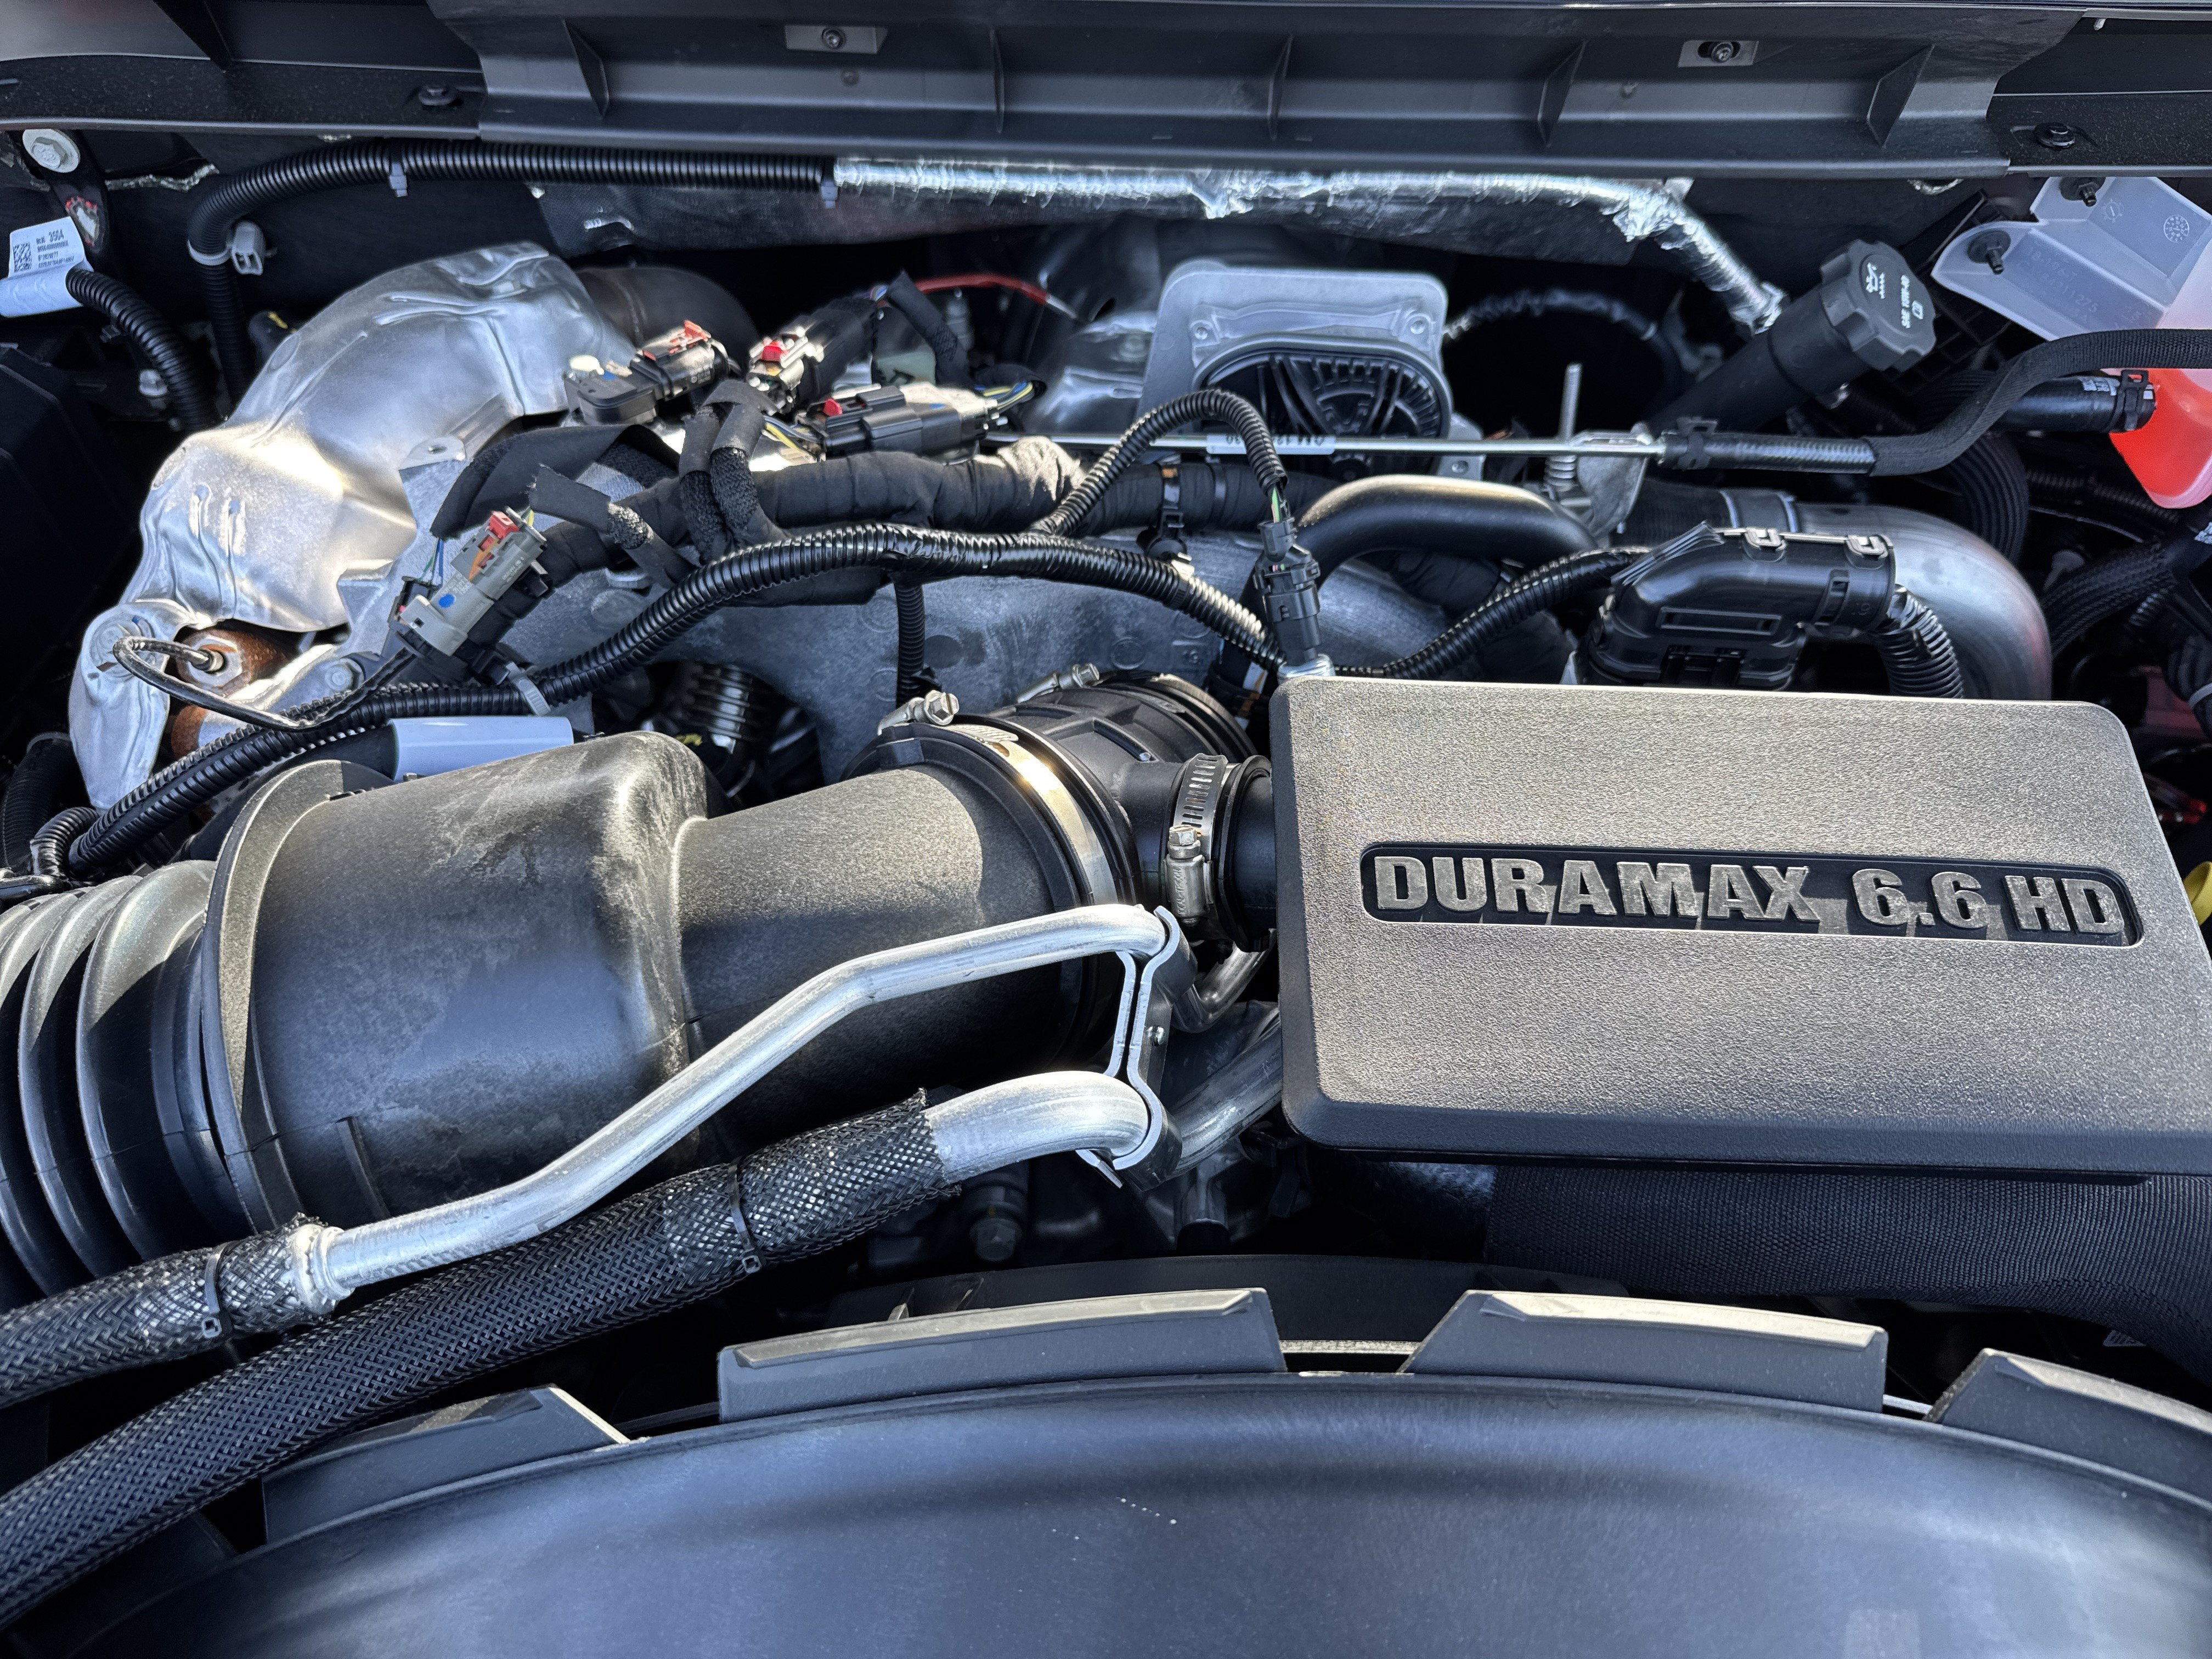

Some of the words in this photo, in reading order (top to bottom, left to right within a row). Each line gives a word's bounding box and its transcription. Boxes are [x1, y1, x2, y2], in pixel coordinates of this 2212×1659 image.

[1374, 856, 1820, 922] DURAMAX
[1852, 868, 1988, 929] 6.6
[2004, 875, 2125, 934] HD
